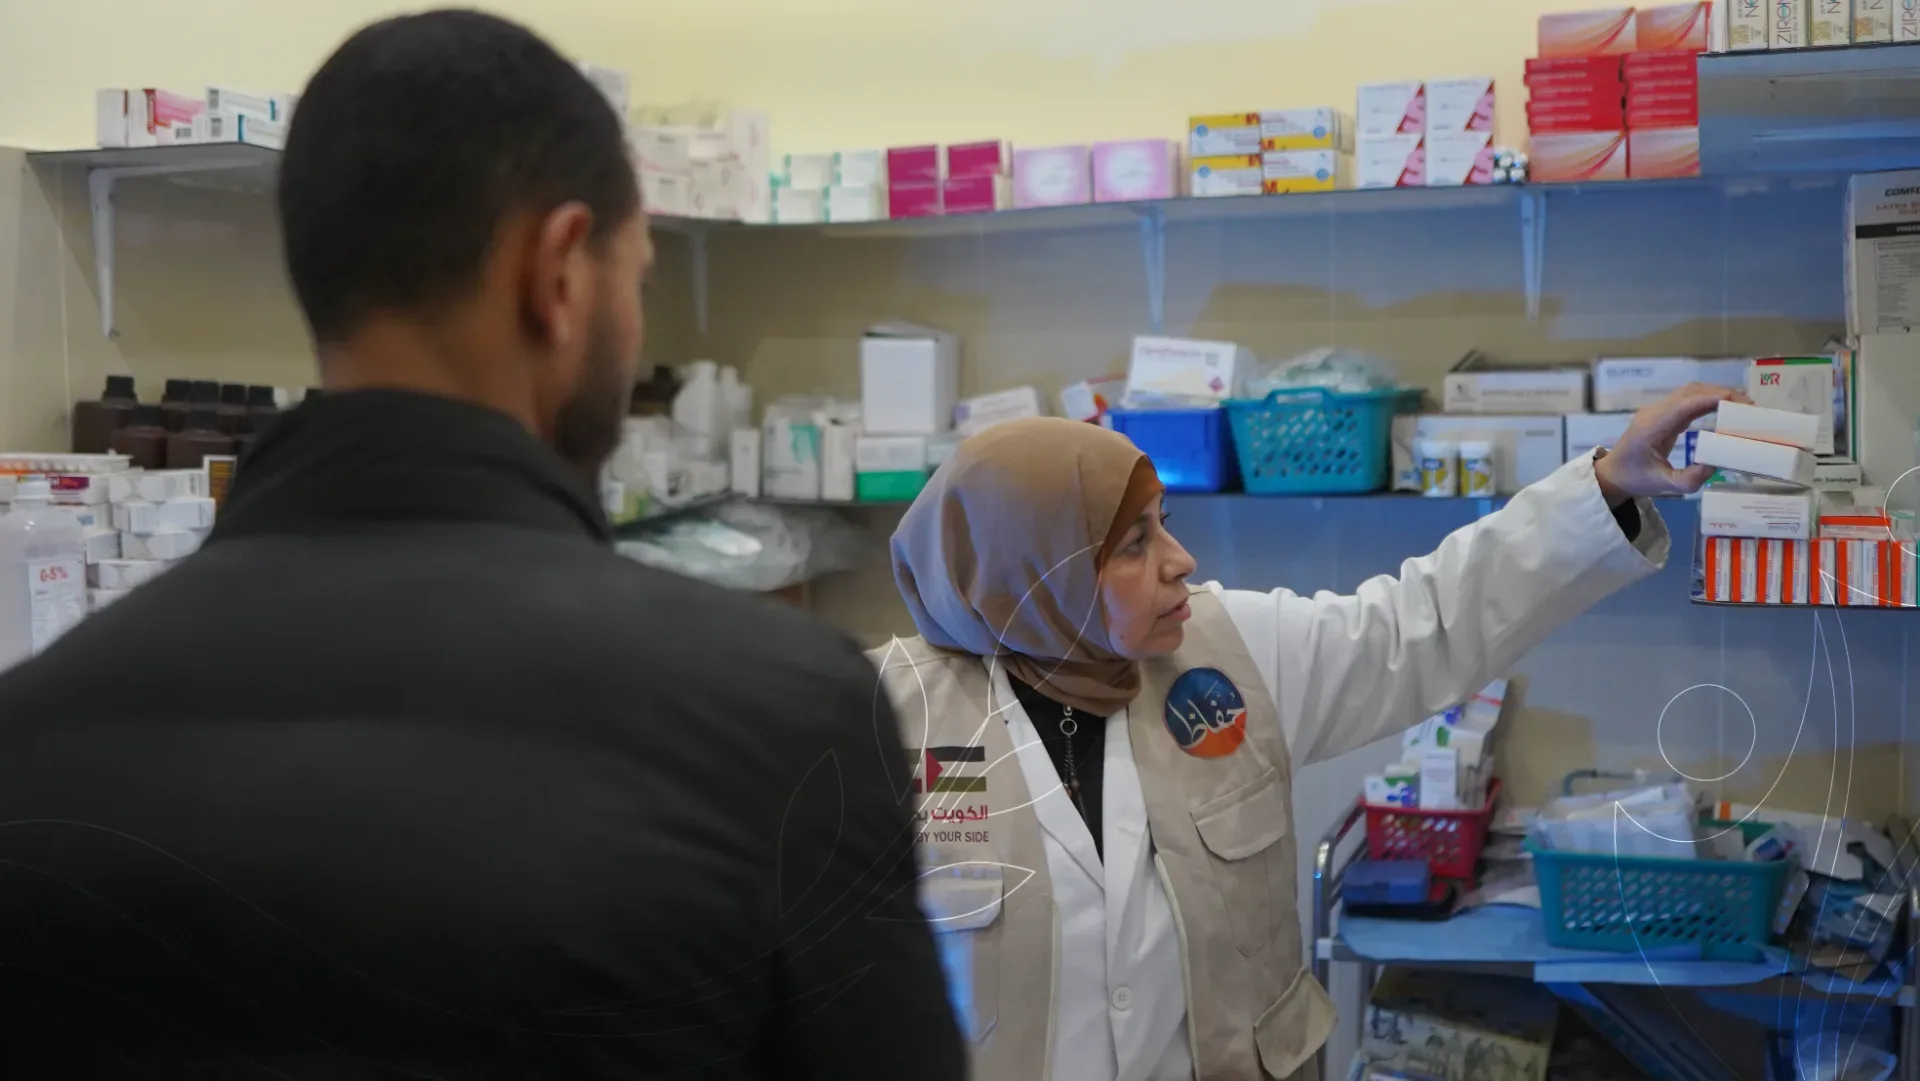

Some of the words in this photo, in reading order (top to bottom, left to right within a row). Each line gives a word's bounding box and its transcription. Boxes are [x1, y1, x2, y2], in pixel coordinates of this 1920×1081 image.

[931, 805, 988, 823] الكويت
[933, 831, 962, 843] YOUR
[965, 831, 990, 843] SIDE
